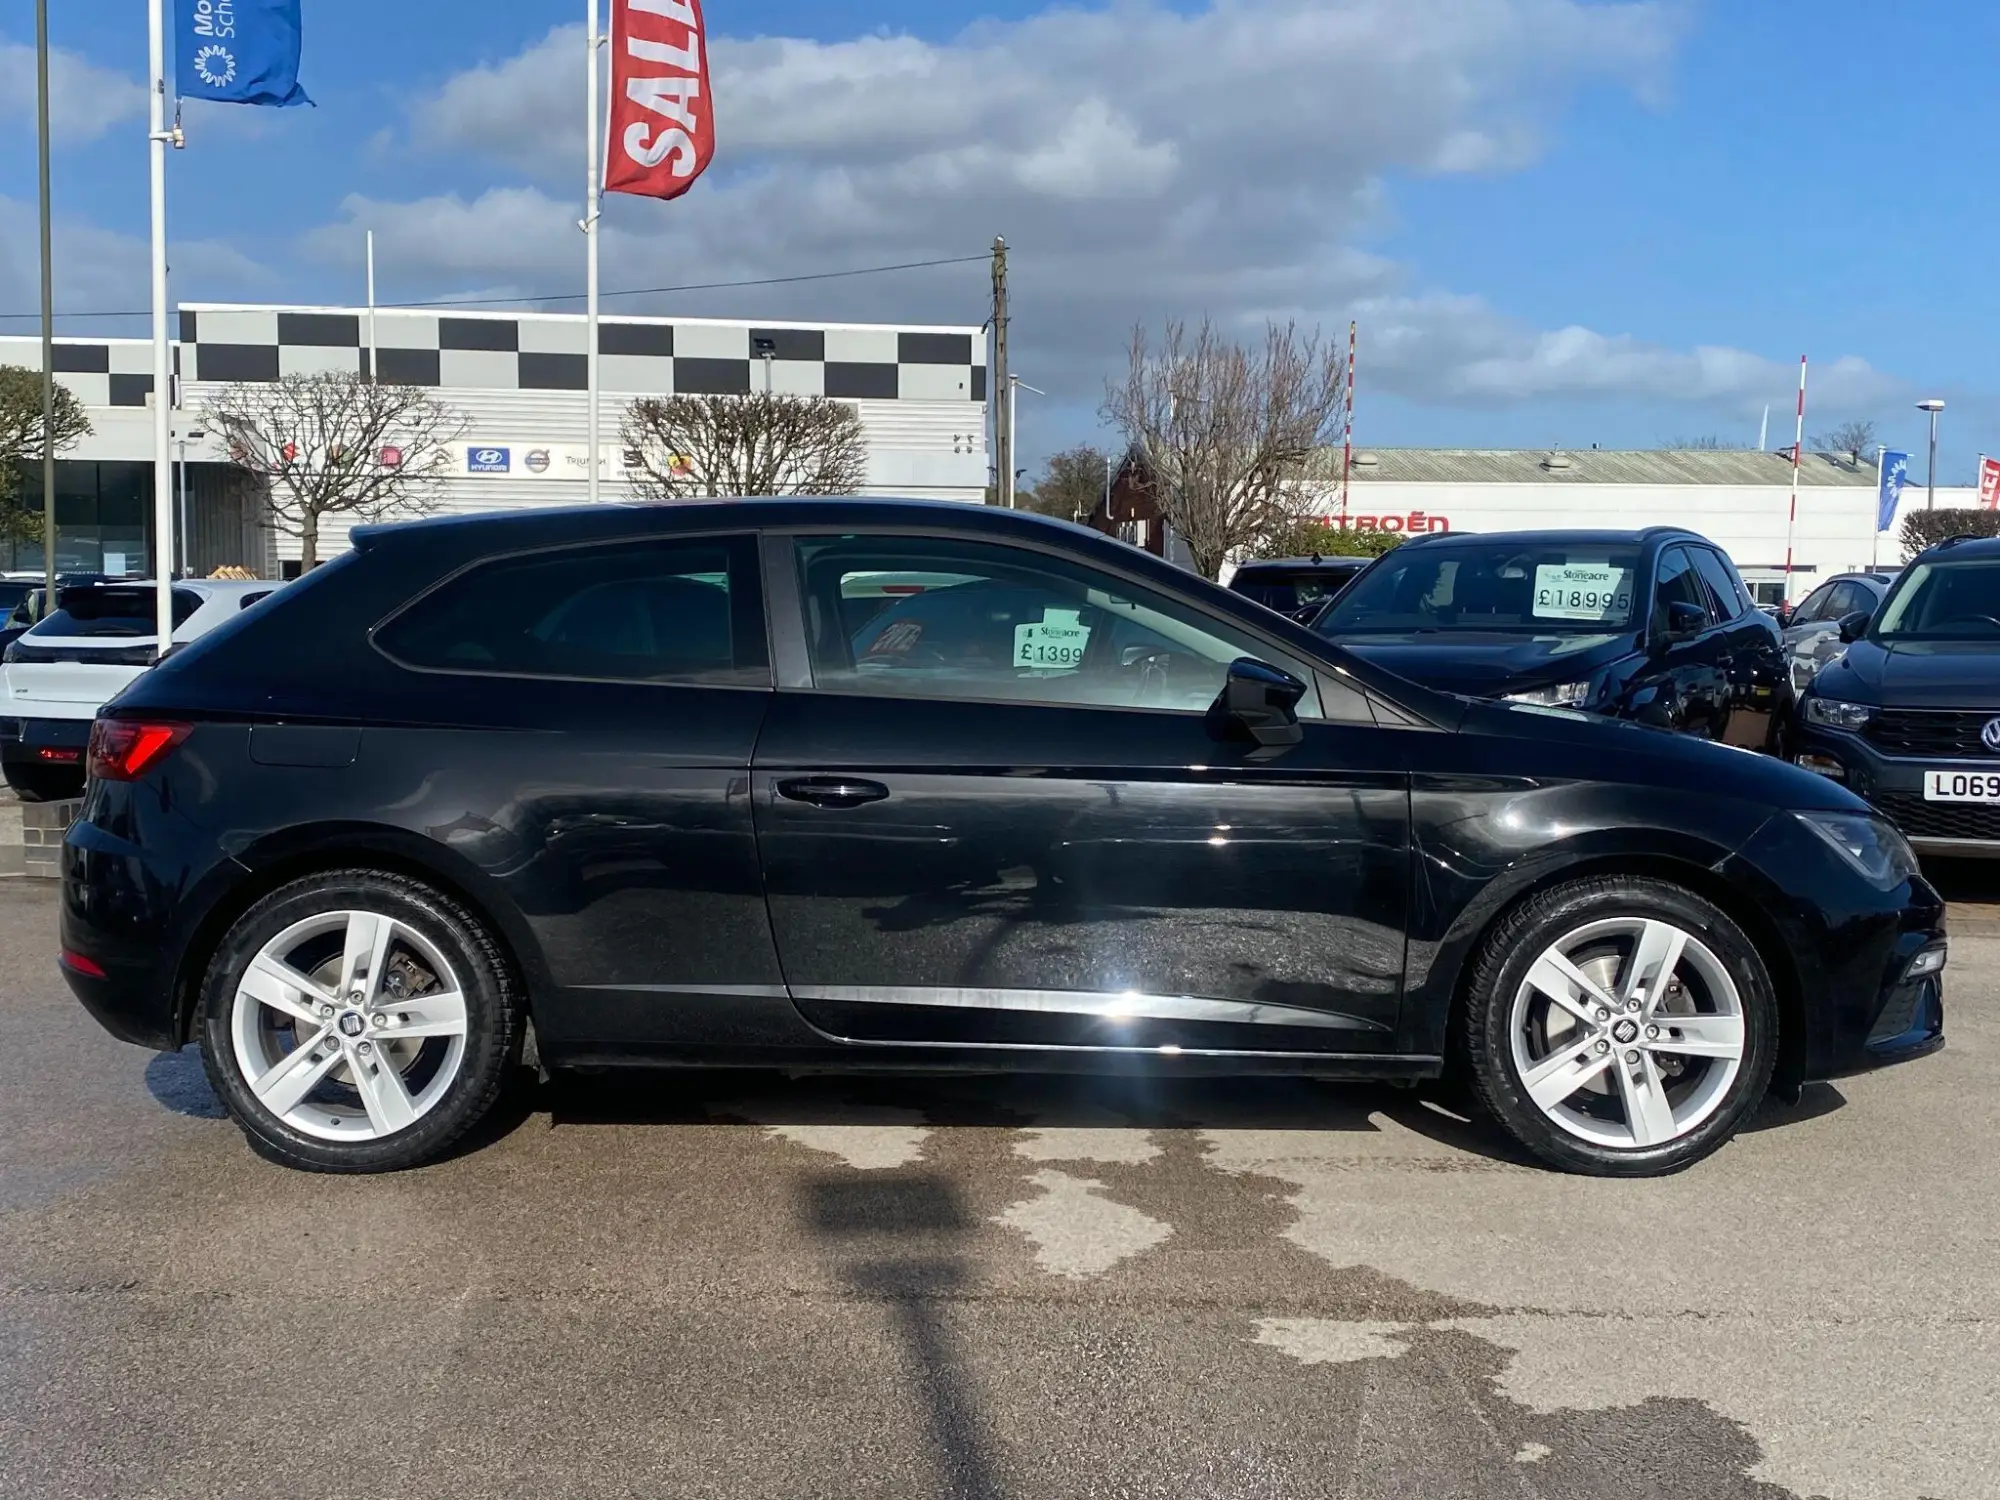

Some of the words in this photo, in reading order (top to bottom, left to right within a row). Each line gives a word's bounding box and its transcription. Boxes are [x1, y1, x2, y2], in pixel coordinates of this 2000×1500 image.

[214, 0, 235, 39] Sch
[565, 456, 606, 466] TRIUH
[470, 464, 507, 472] HYUNDAI
[1563, 569, 1609, 581] Stoneacre
[1539, 589, 1629, 610] £18995
